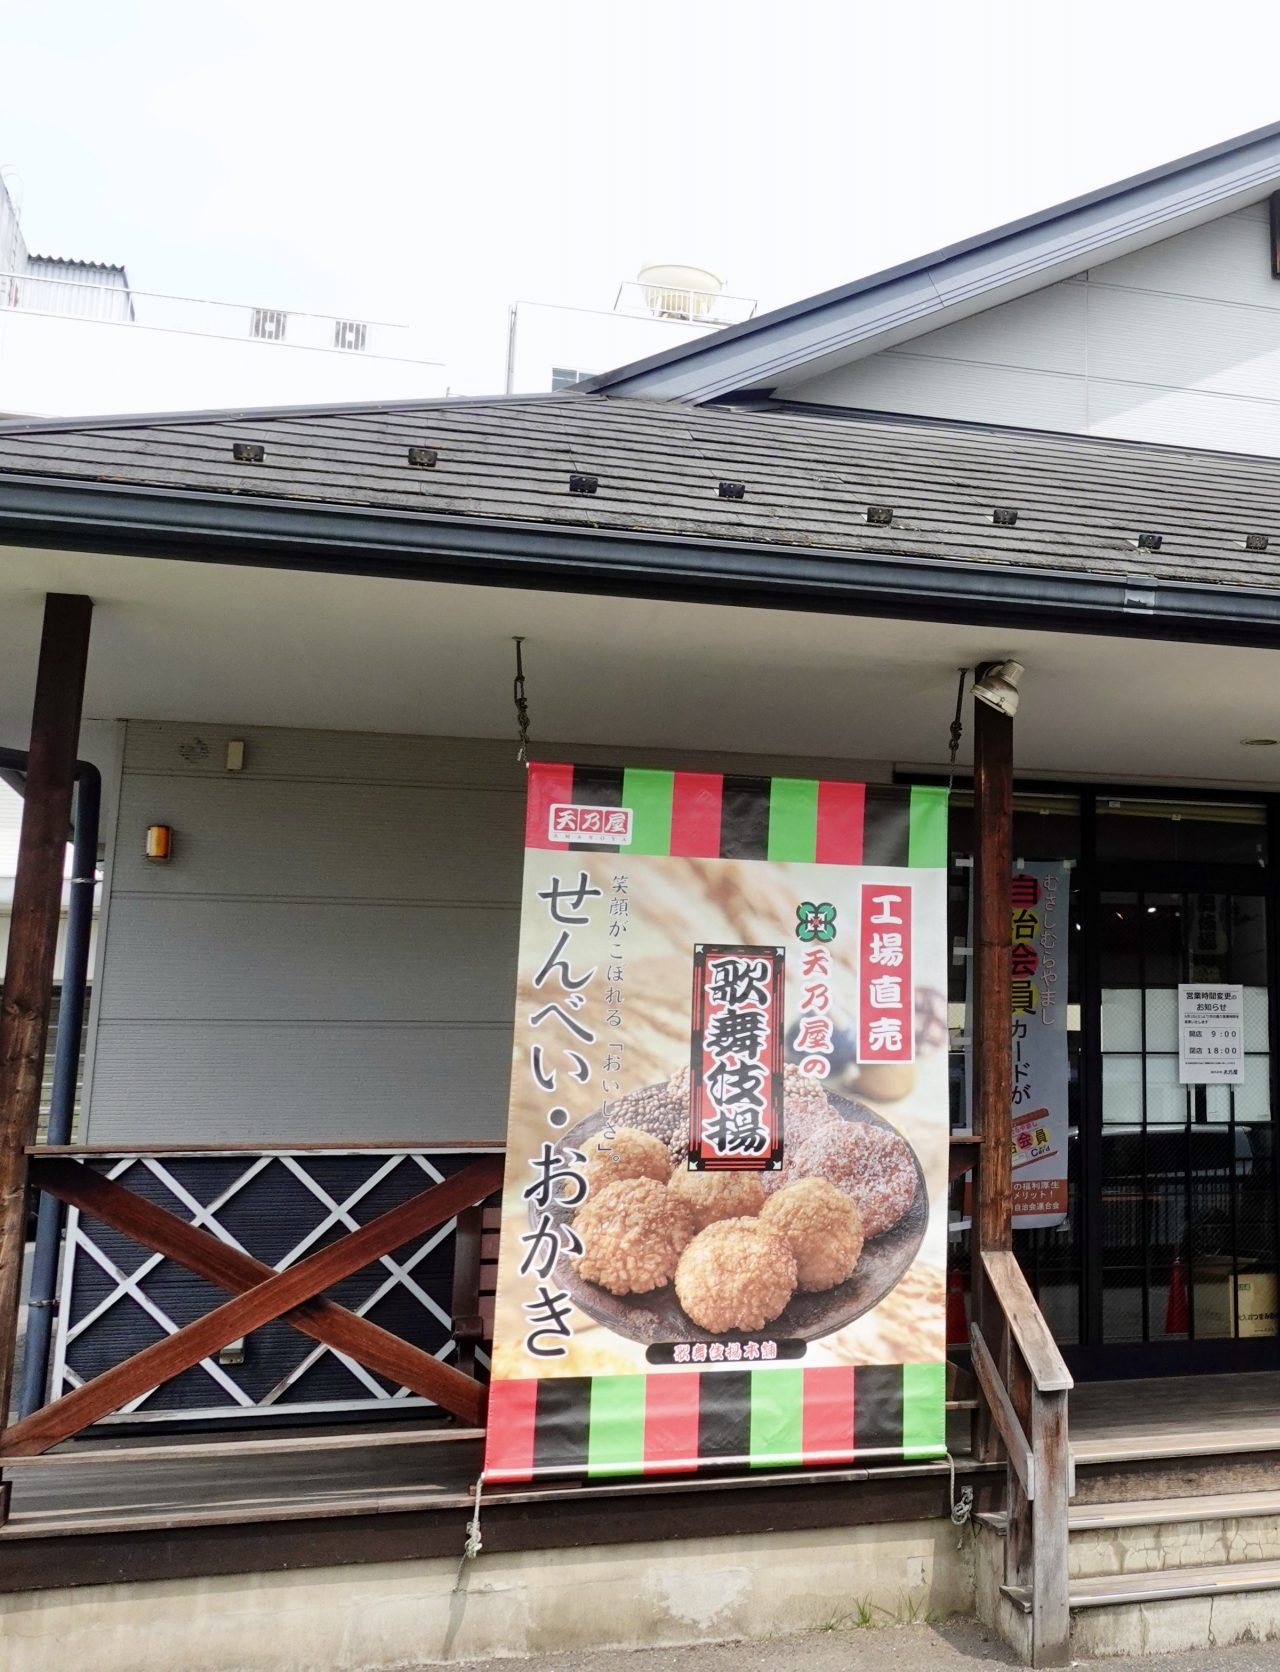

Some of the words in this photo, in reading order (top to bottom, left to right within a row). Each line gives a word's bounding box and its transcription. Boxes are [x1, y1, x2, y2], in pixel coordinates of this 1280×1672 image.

[556, 810, 626, 832] 天乃屋
[868, 895, 904, 1051] 工場直売
[1186, 992, 1237, 1000] 営業時間変更の
[1197, 1003, 1227, 1011] お知らせ
[798, 949, 830, 1075] 天乃屋の
[705, 957, 770, 1156] 歌舞伎揚
[521, 873, 601, 1355] せんべい・おかき
[673, 1341, 778, 1362] 歌舞伎揚本舗
